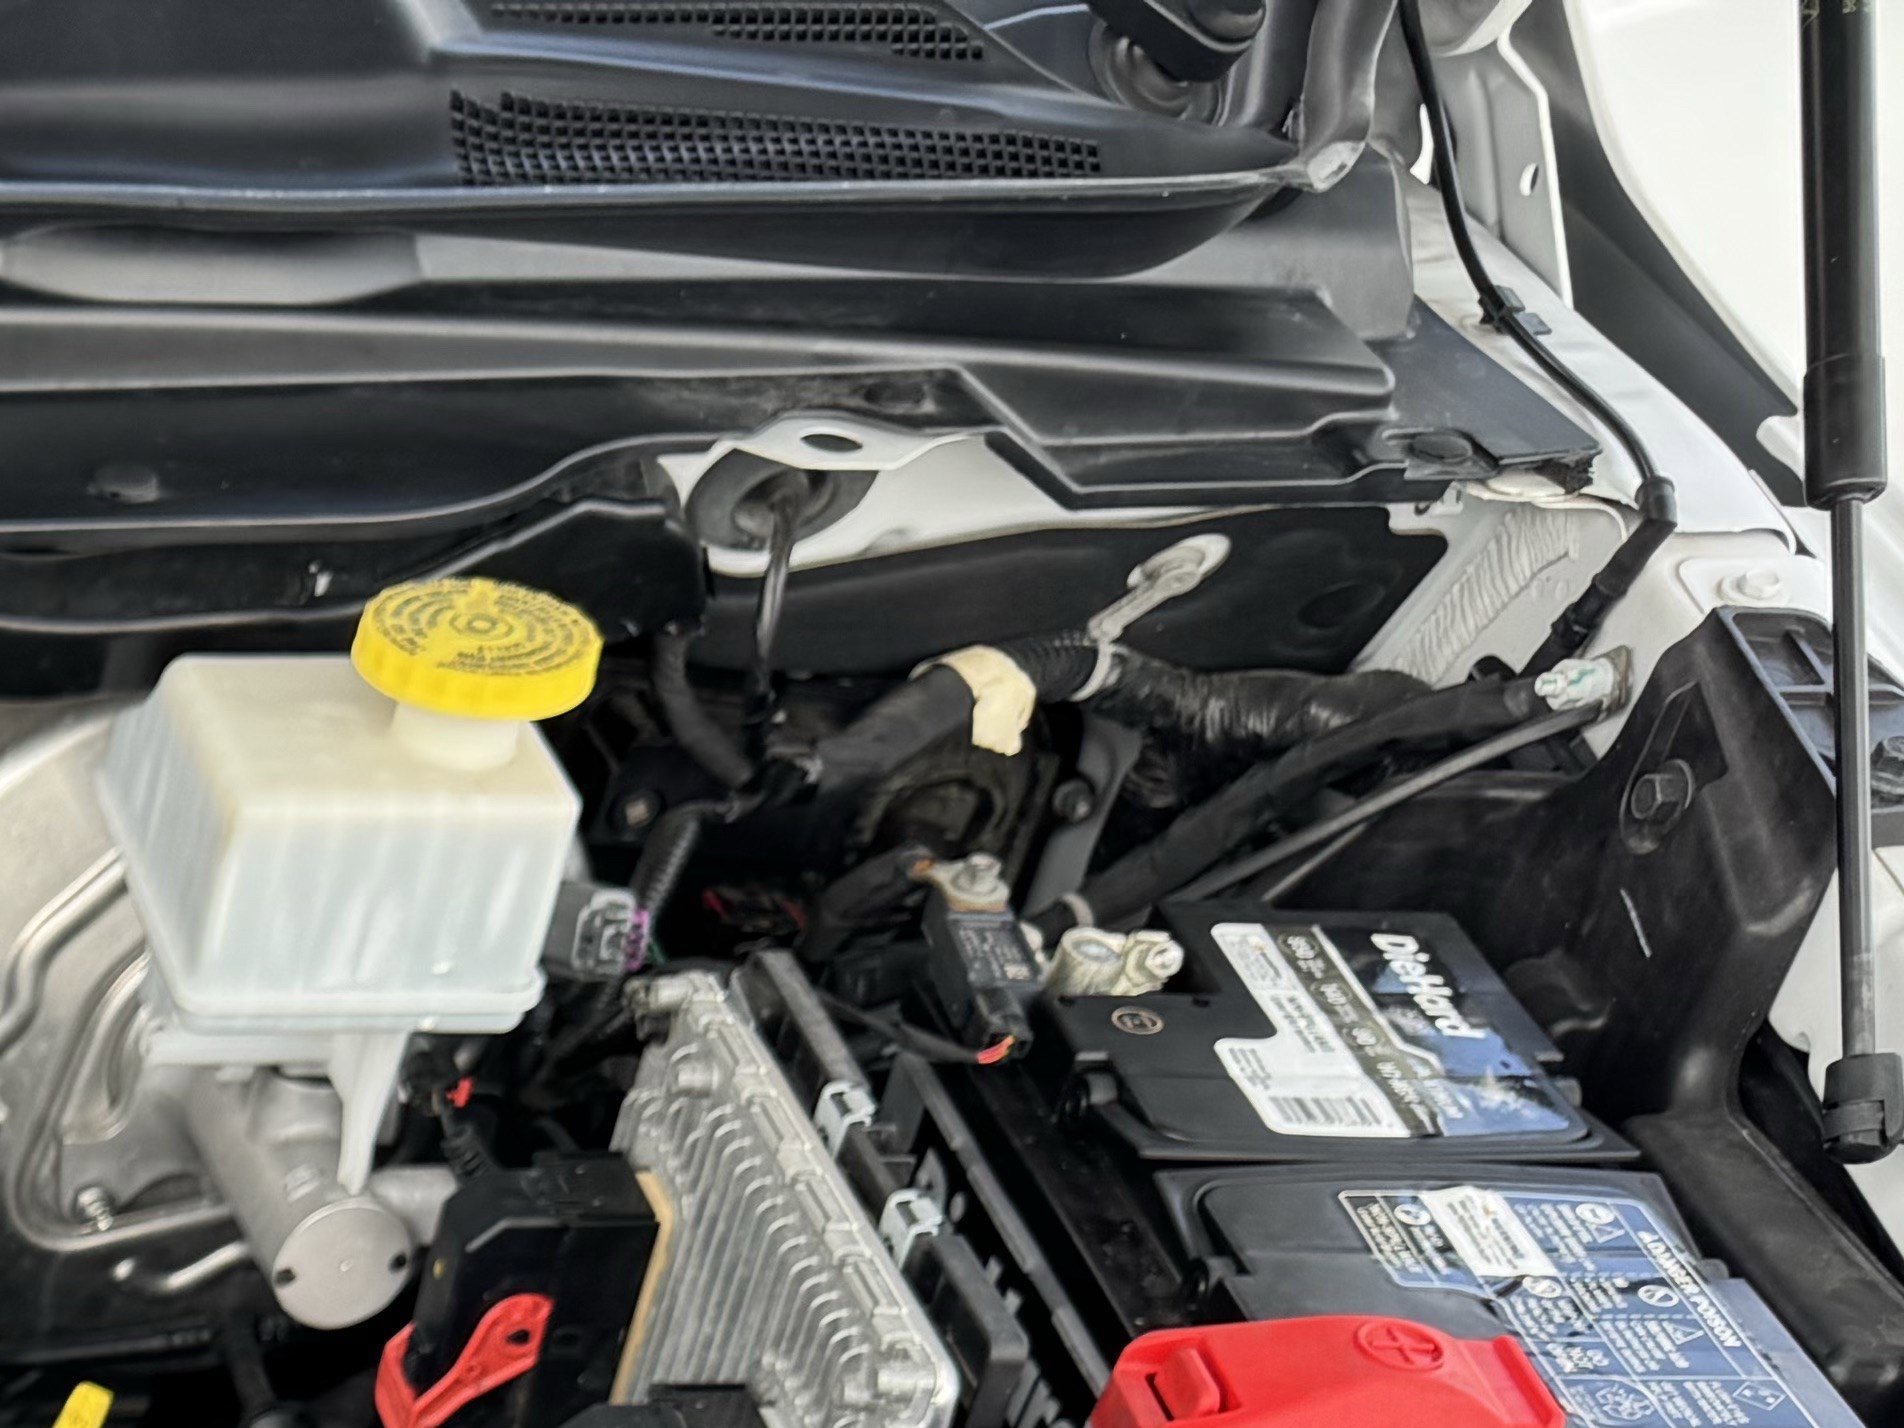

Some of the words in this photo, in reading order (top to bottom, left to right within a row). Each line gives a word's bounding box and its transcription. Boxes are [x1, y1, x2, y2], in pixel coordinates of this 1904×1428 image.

[1370, 932, 1487, 1038] DieHard
[1646, 1241, 1701, 1294] DANGER
[1689, 1295, 1742, 1347] POISON
